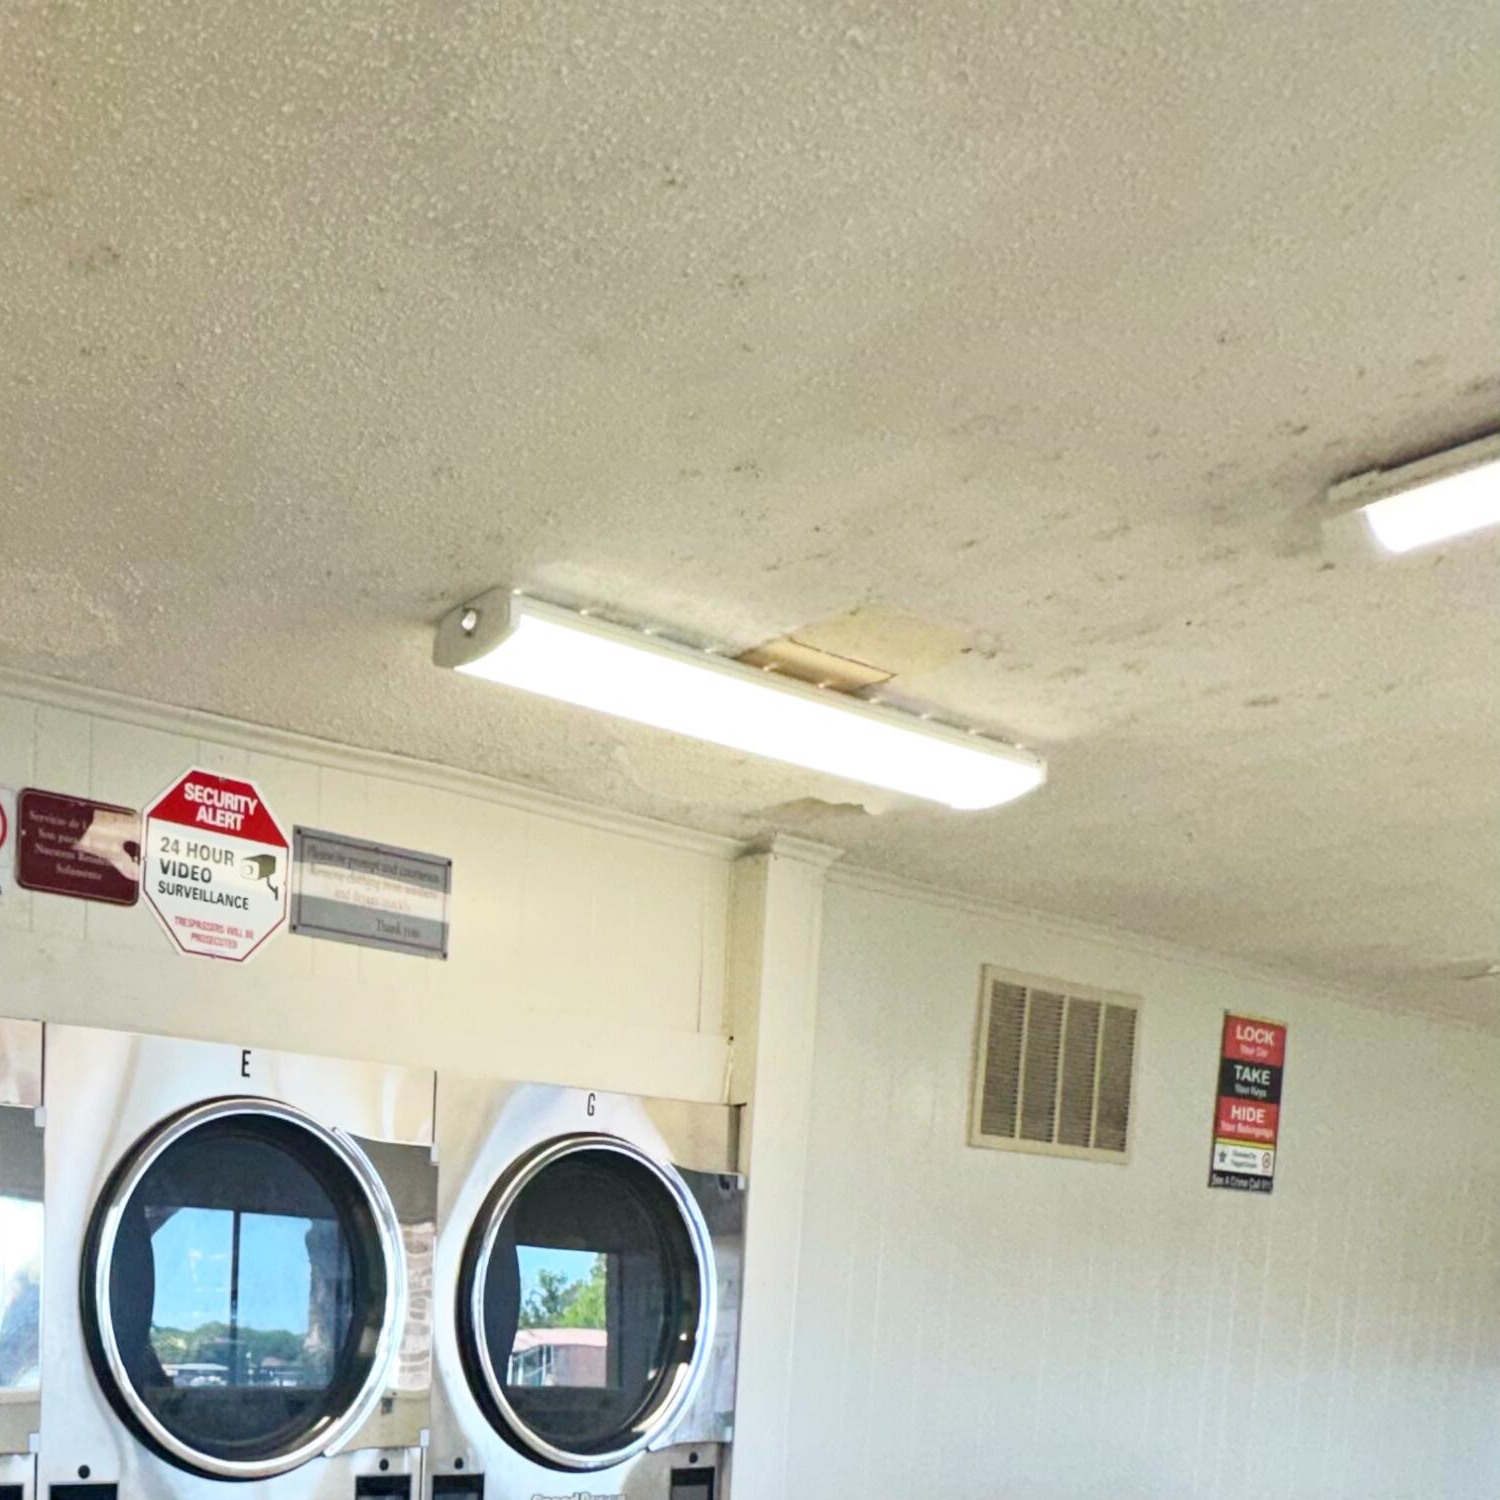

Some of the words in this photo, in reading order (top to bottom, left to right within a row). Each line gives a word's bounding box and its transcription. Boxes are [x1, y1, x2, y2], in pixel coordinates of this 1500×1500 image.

[183, 782, 258, 816] SECURITY
[196, 805, 245, 831] ALERT
[160, 836, 181, 855] 24
[186, 841, 235, 867] HOUR
[159, 858, 212, 884] VIDEO
[158, 880, 250, 911] SURVEILLANCE
[1235, 1024, 1275, 1047] LOCK
[241, 1049, 251, 1077] E
[1233, 1064, 1271, 1085] TAKE
[587, 1092, 596, 1117] G
[1230, 1104, 1266, 1124] HIDE
